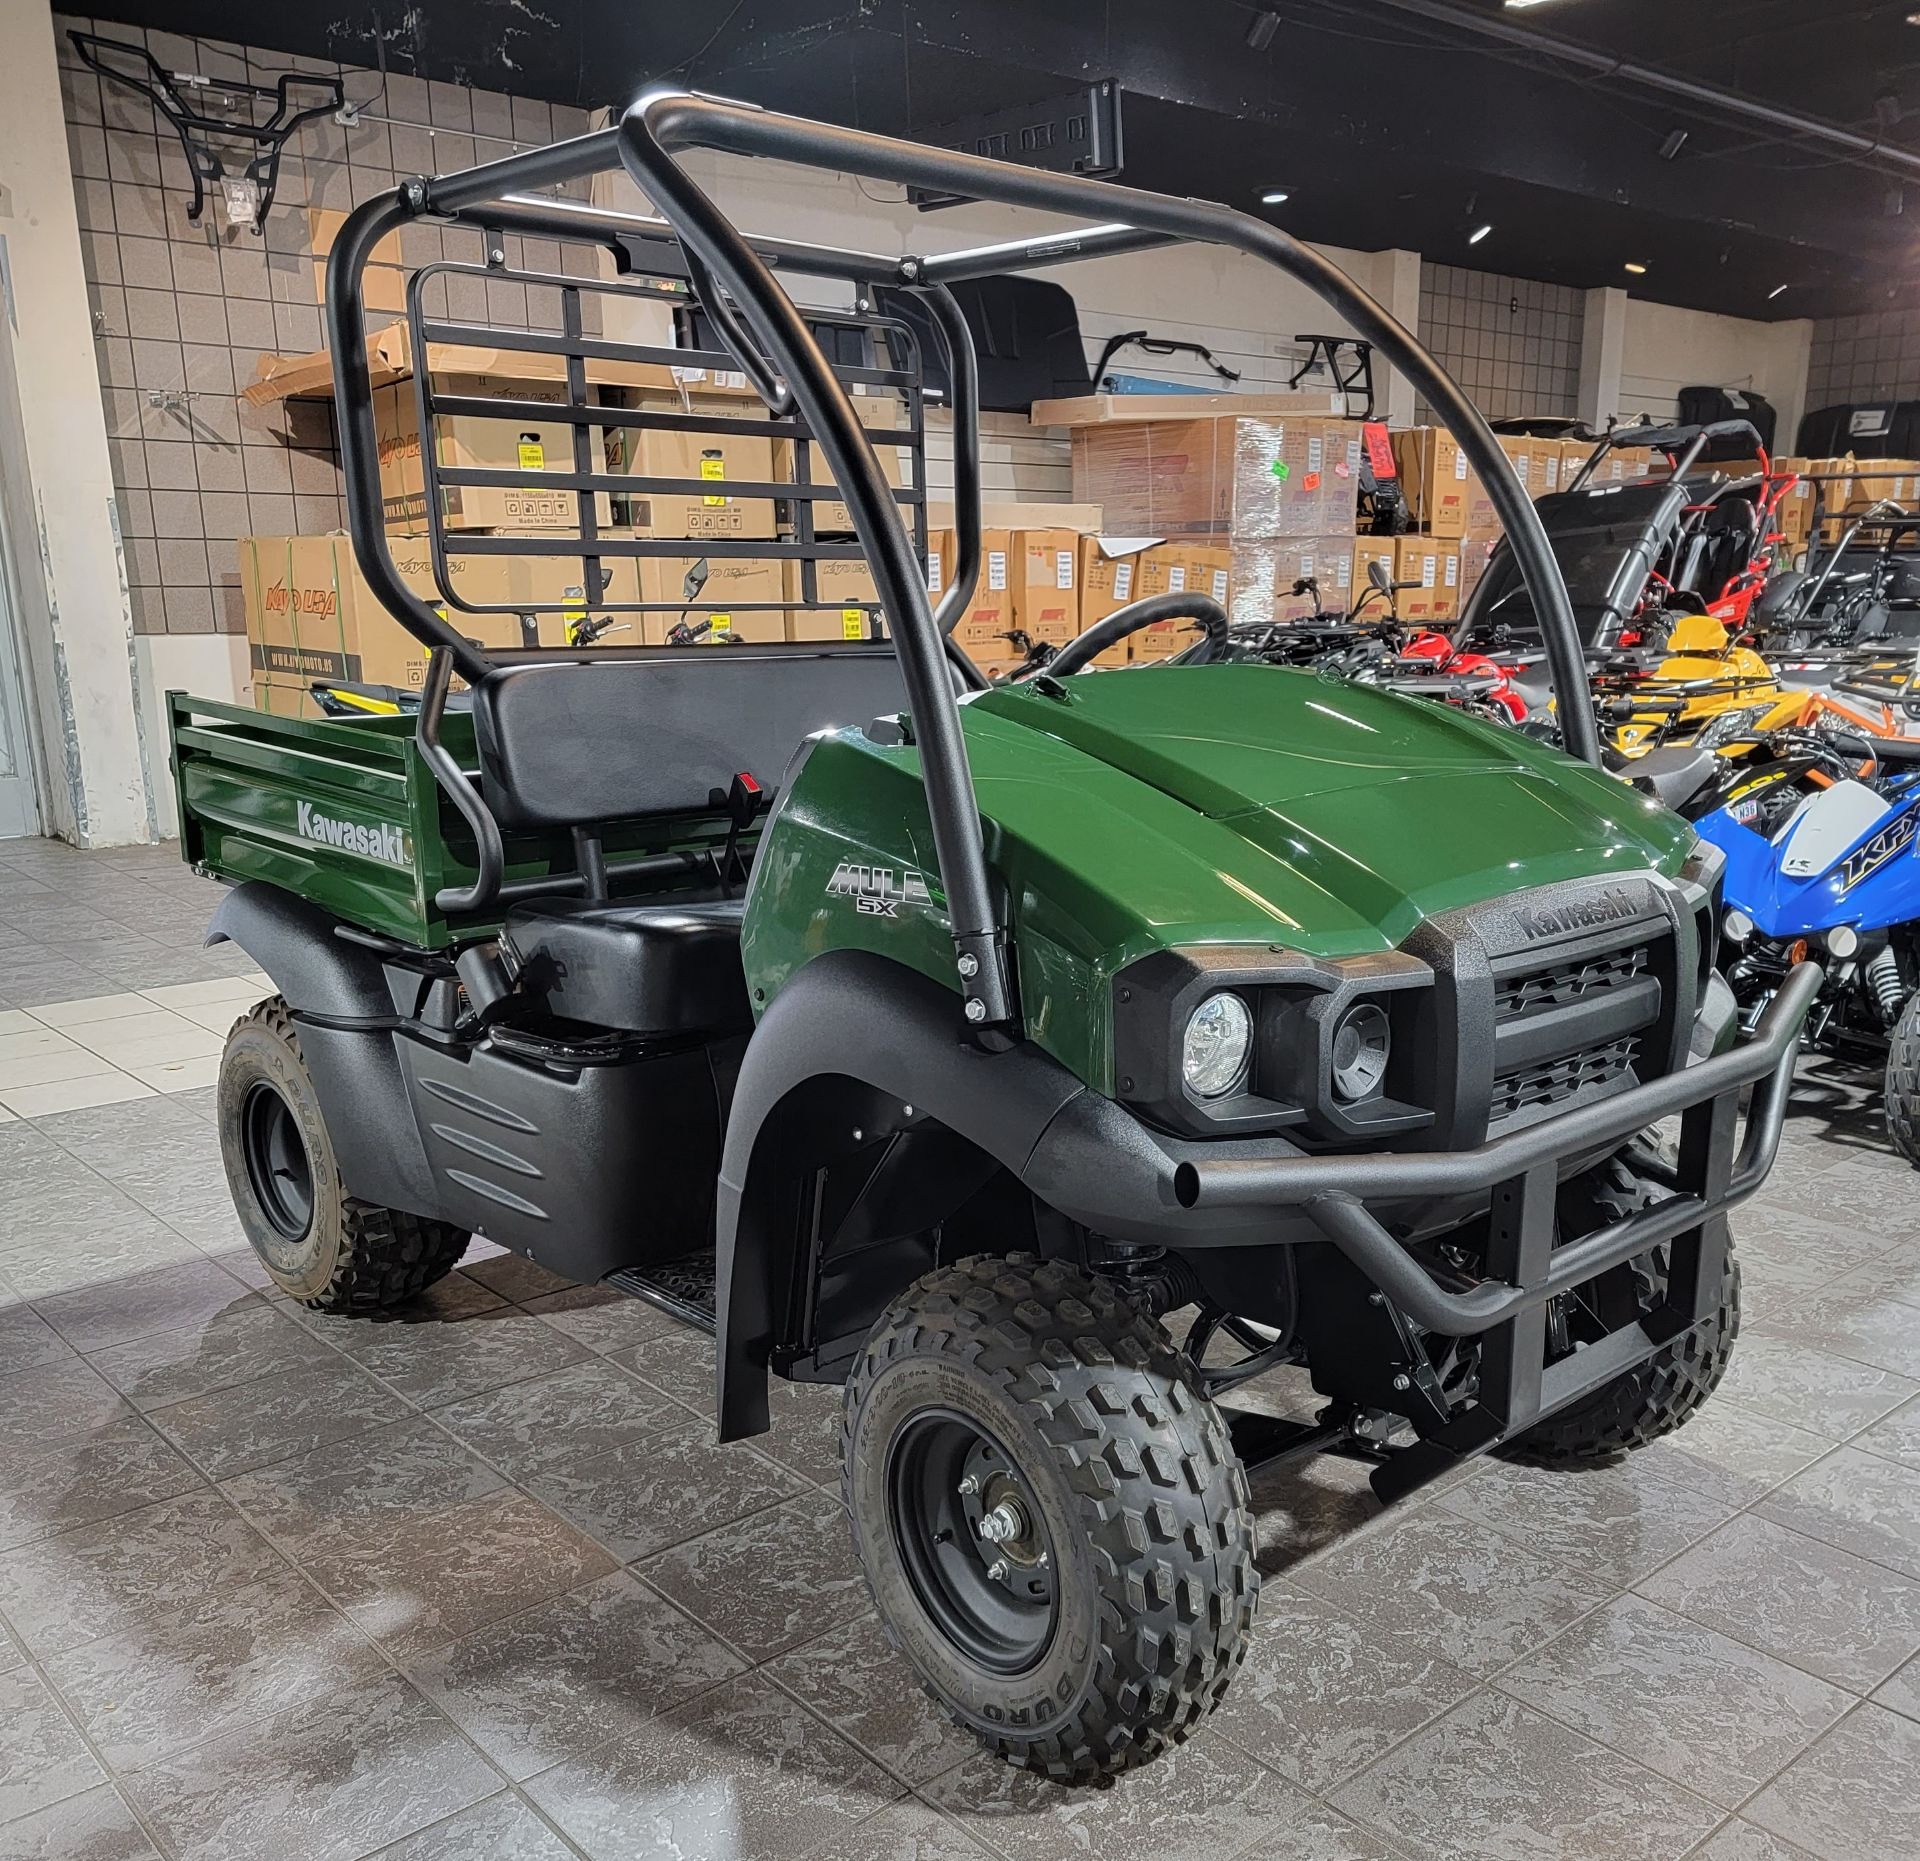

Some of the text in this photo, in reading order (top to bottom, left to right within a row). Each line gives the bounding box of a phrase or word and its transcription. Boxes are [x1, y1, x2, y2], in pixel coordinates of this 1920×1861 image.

[265, 576, 337, 620] KAYO USA
[296, 799, 404, 865] Kawasaki
[825, 863, 933, 906] MULE
[857, 896, 898, 918] SX
[1512, 887, 1638, 941] Kawasaki
[982, 1671, 1076, 1728] DURO
